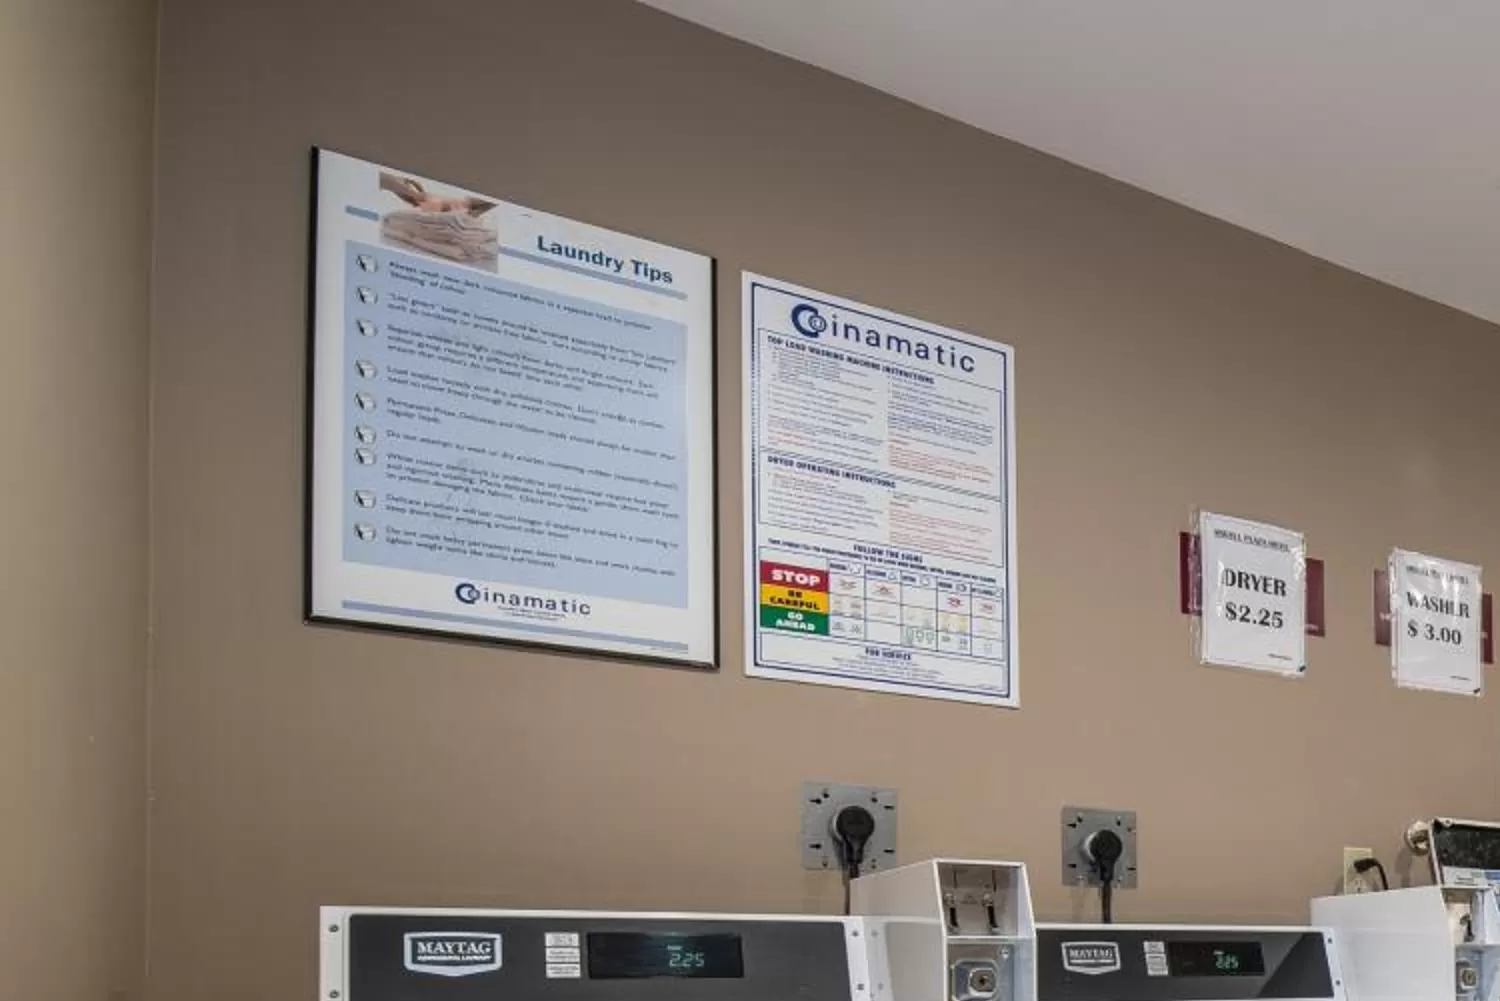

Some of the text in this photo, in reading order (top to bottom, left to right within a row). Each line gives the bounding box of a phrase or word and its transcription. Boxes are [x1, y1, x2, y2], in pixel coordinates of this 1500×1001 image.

[537, 235, 673, 283] Laundry Tips
[771, 569, 821, 586] STOP
[1223, 567, 1287, 597] DRYER
[769, 596, 821, 611] CAREFUL
[787, 612, 804, 621] GO
[1225, 602, 1284, 629] $2.25
[775, 619, 816, 631] AHEAD
[417, 942, 491, 954] MAYTAG
[1069, 948, 1113, 958] MAYTAG
